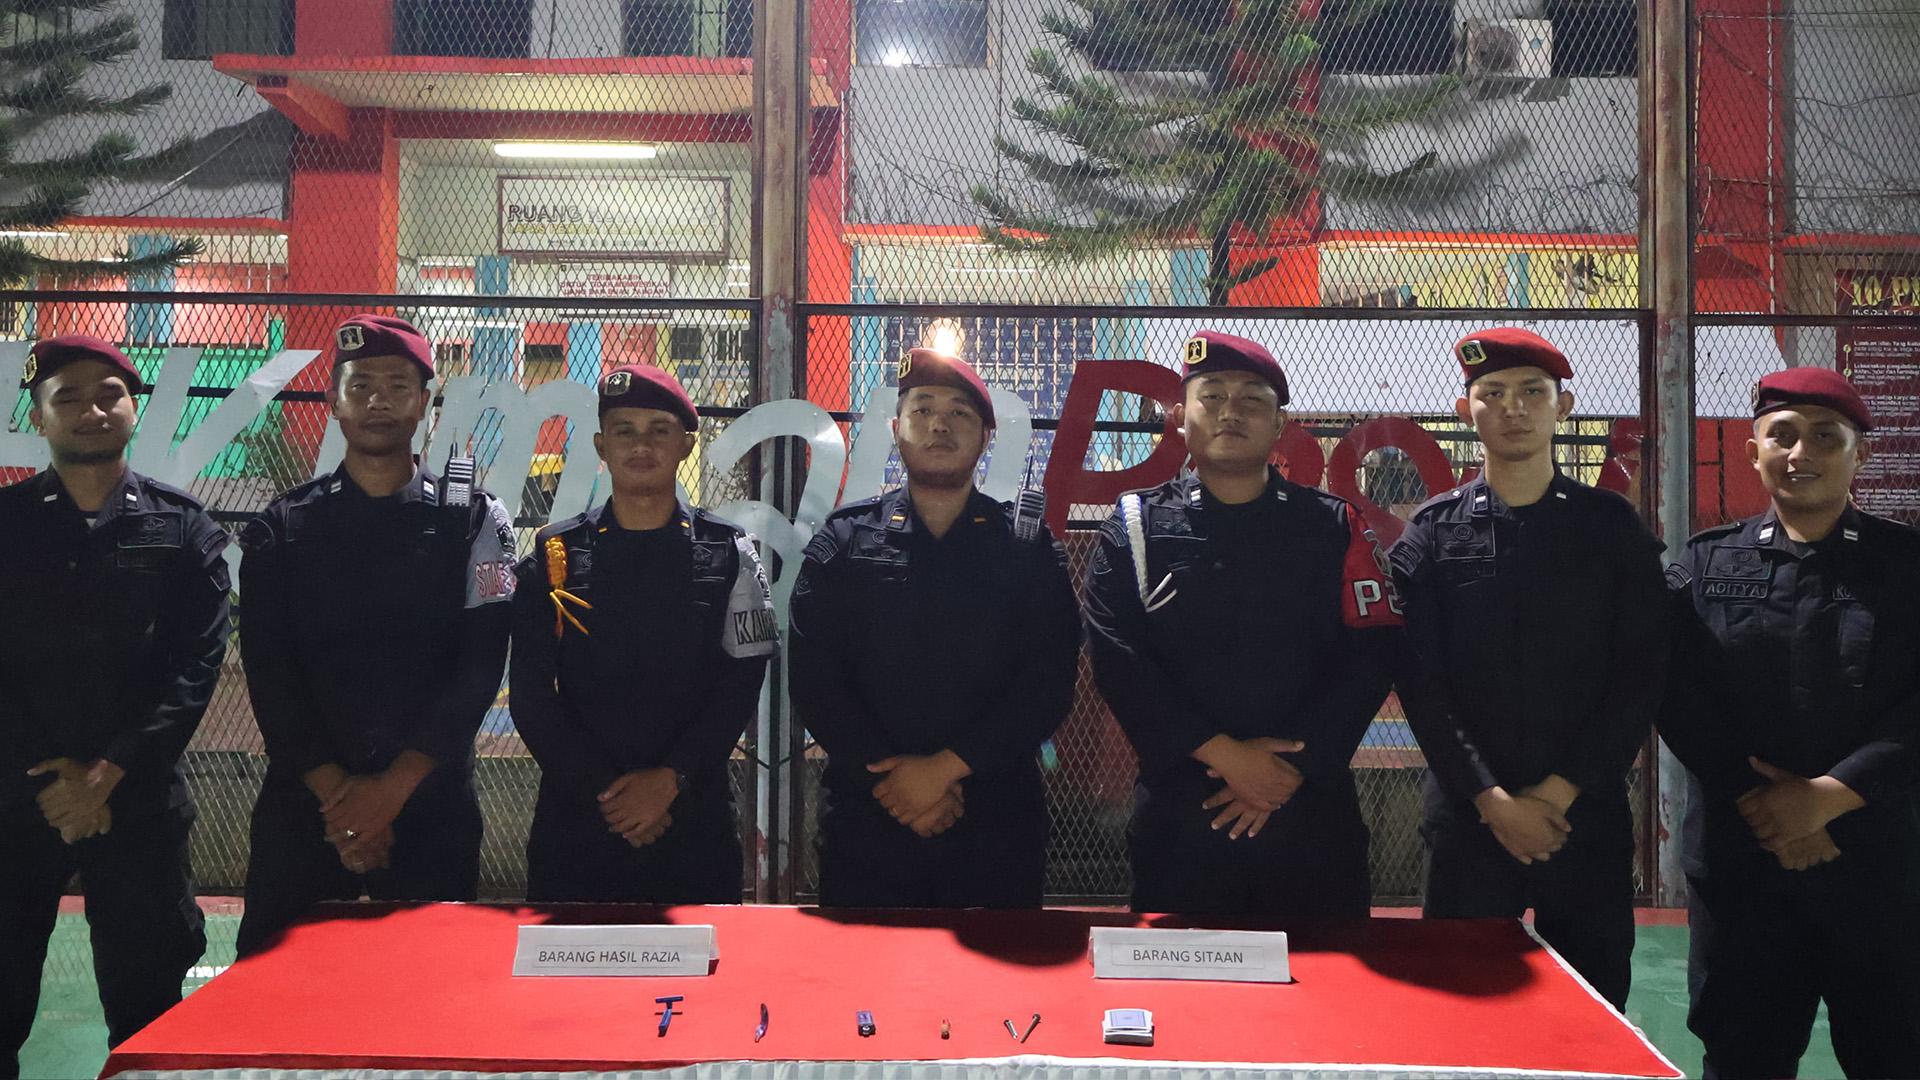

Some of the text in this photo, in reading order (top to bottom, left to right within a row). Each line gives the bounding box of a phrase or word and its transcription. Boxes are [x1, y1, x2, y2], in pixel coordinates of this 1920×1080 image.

[508, 204, 582, 222] RUANG
[1850, 275, 1882, 306] 10
[1704, 582, 1761, 596] ADITYA
[538, 950, 681, 963] BARANG HASIL RAZIA
[1133, 949, 1243, 964] BARANG SITAAN
